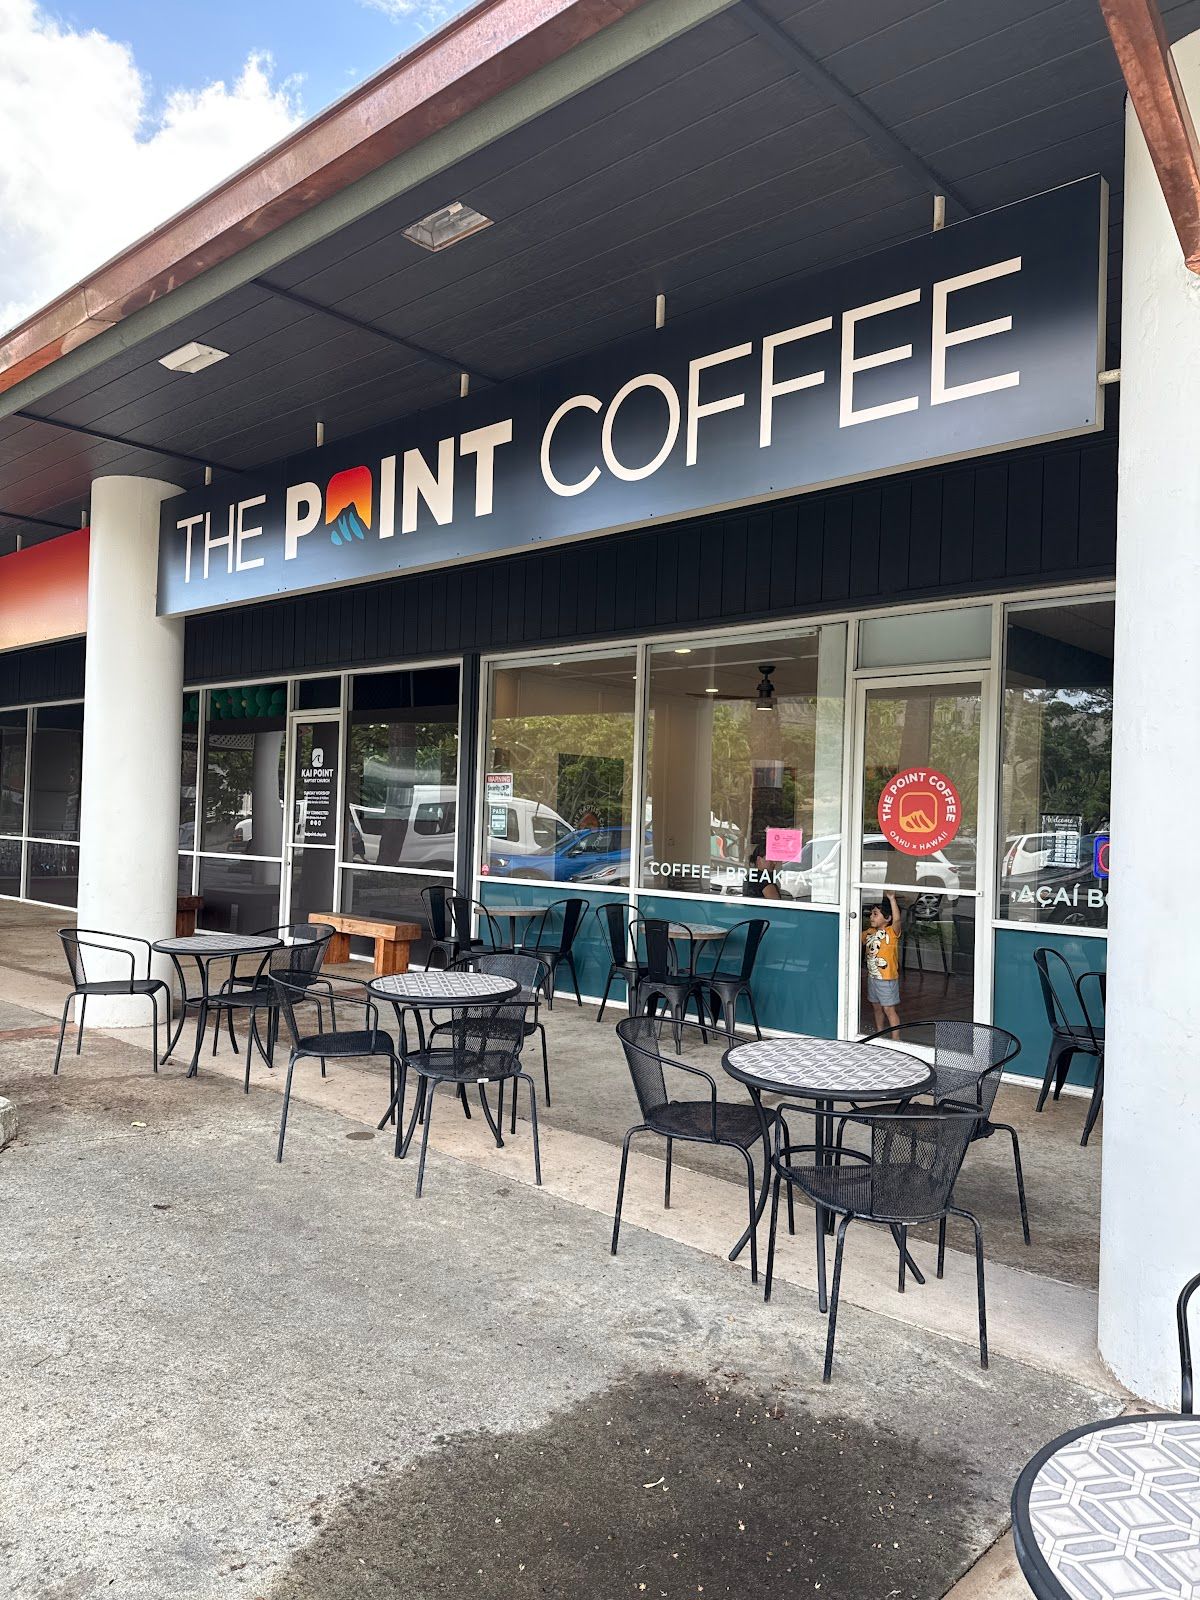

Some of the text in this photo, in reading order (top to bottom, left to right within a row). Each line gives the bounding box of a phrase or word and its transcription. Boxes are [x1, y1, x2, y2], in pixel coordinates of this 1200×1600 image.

[176, 256, 1022, 583] THE POINT COFFEE
[302, 768, 334, 777] KAI POINT
[882, 772, 956, 822] THE POINT COFFEE
[890, 831, 910, 848] OAHU
[920, 831, 948, 850] HAWAII
[650, 862, 817, 887] COFFEE BREAKFAS
[1017, 882, 1080, 908] AÇAÍ
